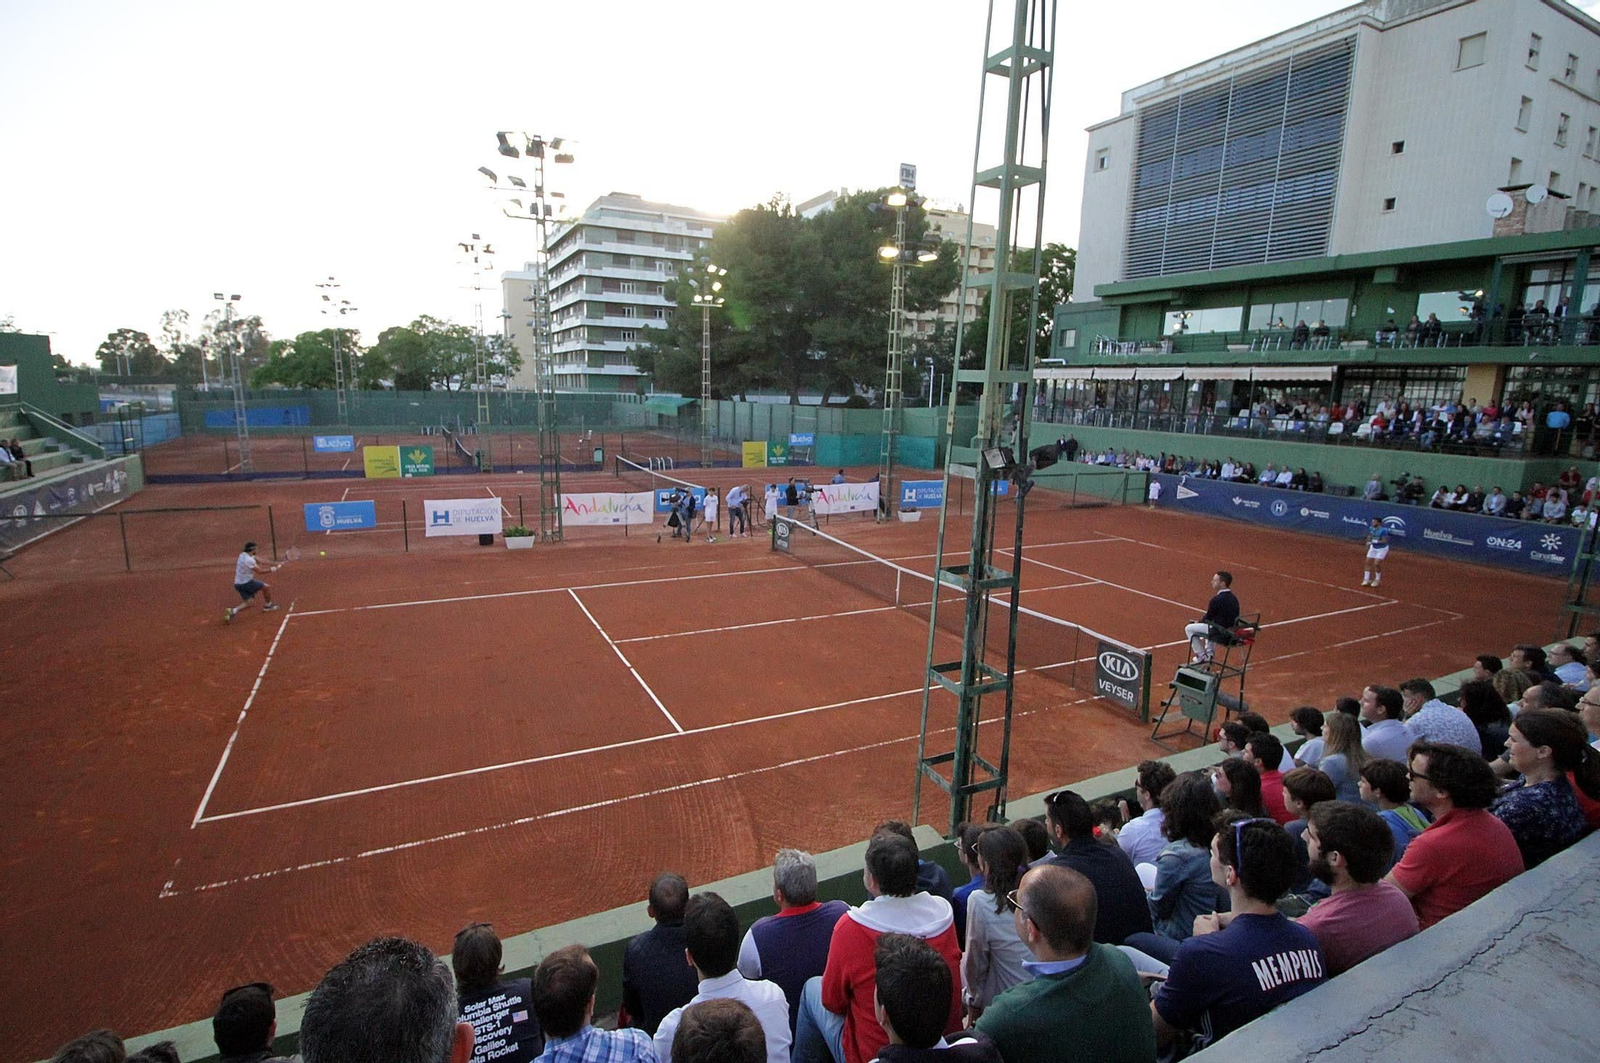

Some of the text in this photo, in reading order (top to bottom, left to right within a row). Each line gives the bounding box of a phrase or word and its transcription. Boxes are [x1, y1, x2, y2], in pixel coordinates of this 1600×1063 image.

[816, 486, 873, 504] Andalucía
[452, 507, 498, 516] DIPUTACIÓN
[563, 496, 645, 515] Andalucía
[1423, 528, 1453, 540] Huelva
[1105, 655, 1132, 678] KIA
[1098, 679, 1134, 702] VEYSER
[1251, 949, 1323, 991] MEMPHIS
[456, 996, 522, 1024] olumbia Shuttle
[464, 993, 506, 1013] Solar Max
[469, 1008, 509, 1027] hallenger
[474, 1020, 500, 1036] STS-1
[474, 1025, 512, 1044] iscovery
[474, 1038, 506, 1055] Galileo
[487, 1042, 519, 1060] Rocket
